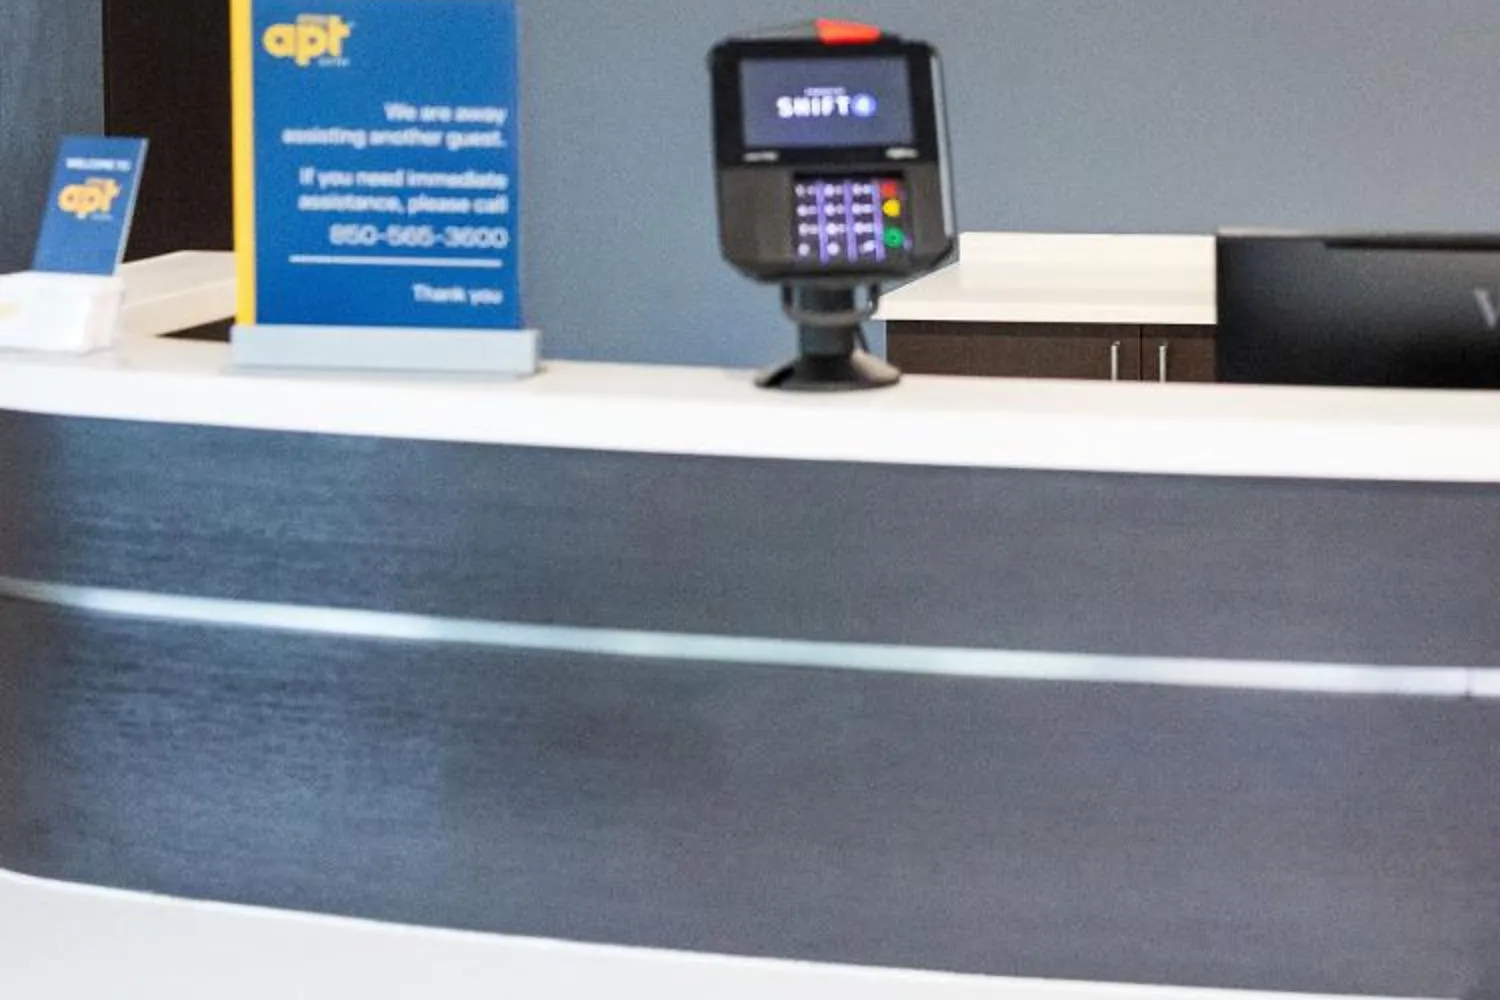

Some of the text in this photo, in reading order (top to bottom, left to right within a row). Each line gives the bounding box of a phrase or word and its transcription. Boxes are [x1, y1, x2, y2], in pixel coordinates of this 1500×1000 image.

[263, 14, 350, 67] apt
[383, 102, 508, 127] We are away
[281, 126, 367, 149] assisting
[368, 126, 443, 147] another
[299, 167, 508, 190] If you need immediate
[407, 193, 472, 216] please
[473, 194, 508, 215] call
[412, 283, 504, 306] Thank you
